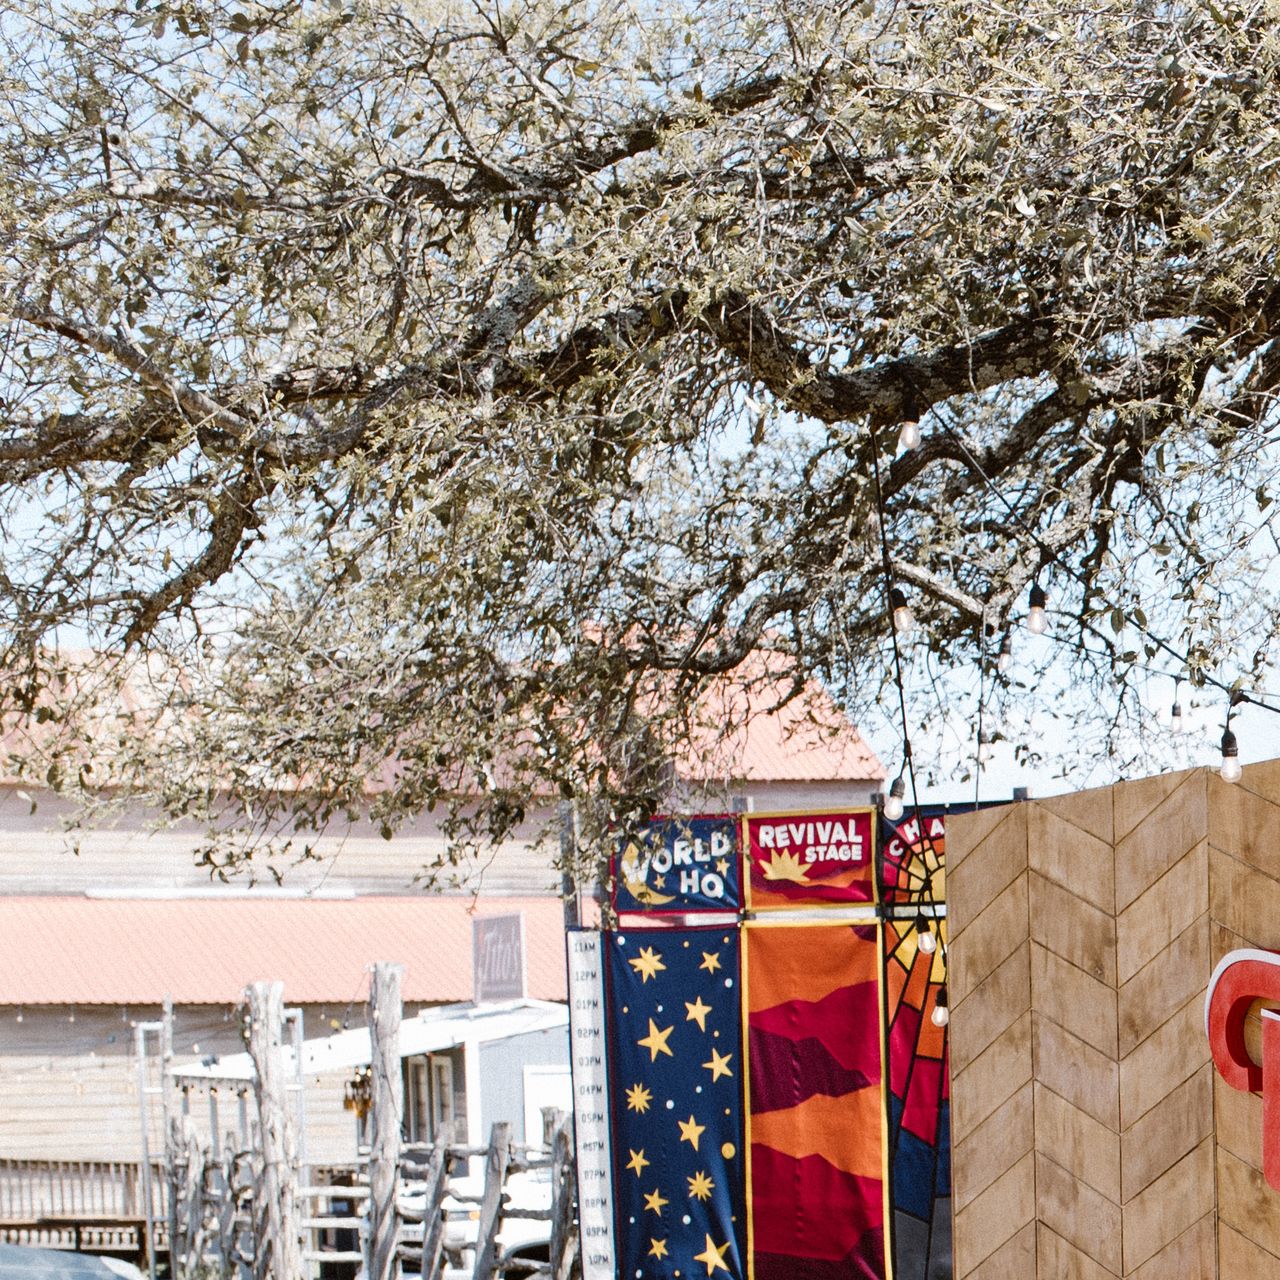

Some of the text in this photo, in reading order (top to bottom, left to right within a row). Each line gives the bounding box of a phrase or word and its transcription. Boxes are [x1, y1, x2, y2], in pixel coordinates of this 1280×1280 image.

[759, 819, 863, 848] REVIVAL
[621, 831, 731, 884] WORLD
[805, 844, 862, 863] STAGE
[680, 869, 724, 899] HQ
[575, 942, 596, 952] 11AM
[575, 971, 597, 981] 12PM
[576, 1000, 598, 1010] 01PM
[577, 1028, 600, 1038] 02PM
[579, 1057, 601, 1067] 03PM
[580, 1085, 602, 1095] 04PM
[581, 1113, 604, 1124] 05PM
[584, 1170, 606, 1180] 07PM
[586, 1227, 608, 1237] 09PM
